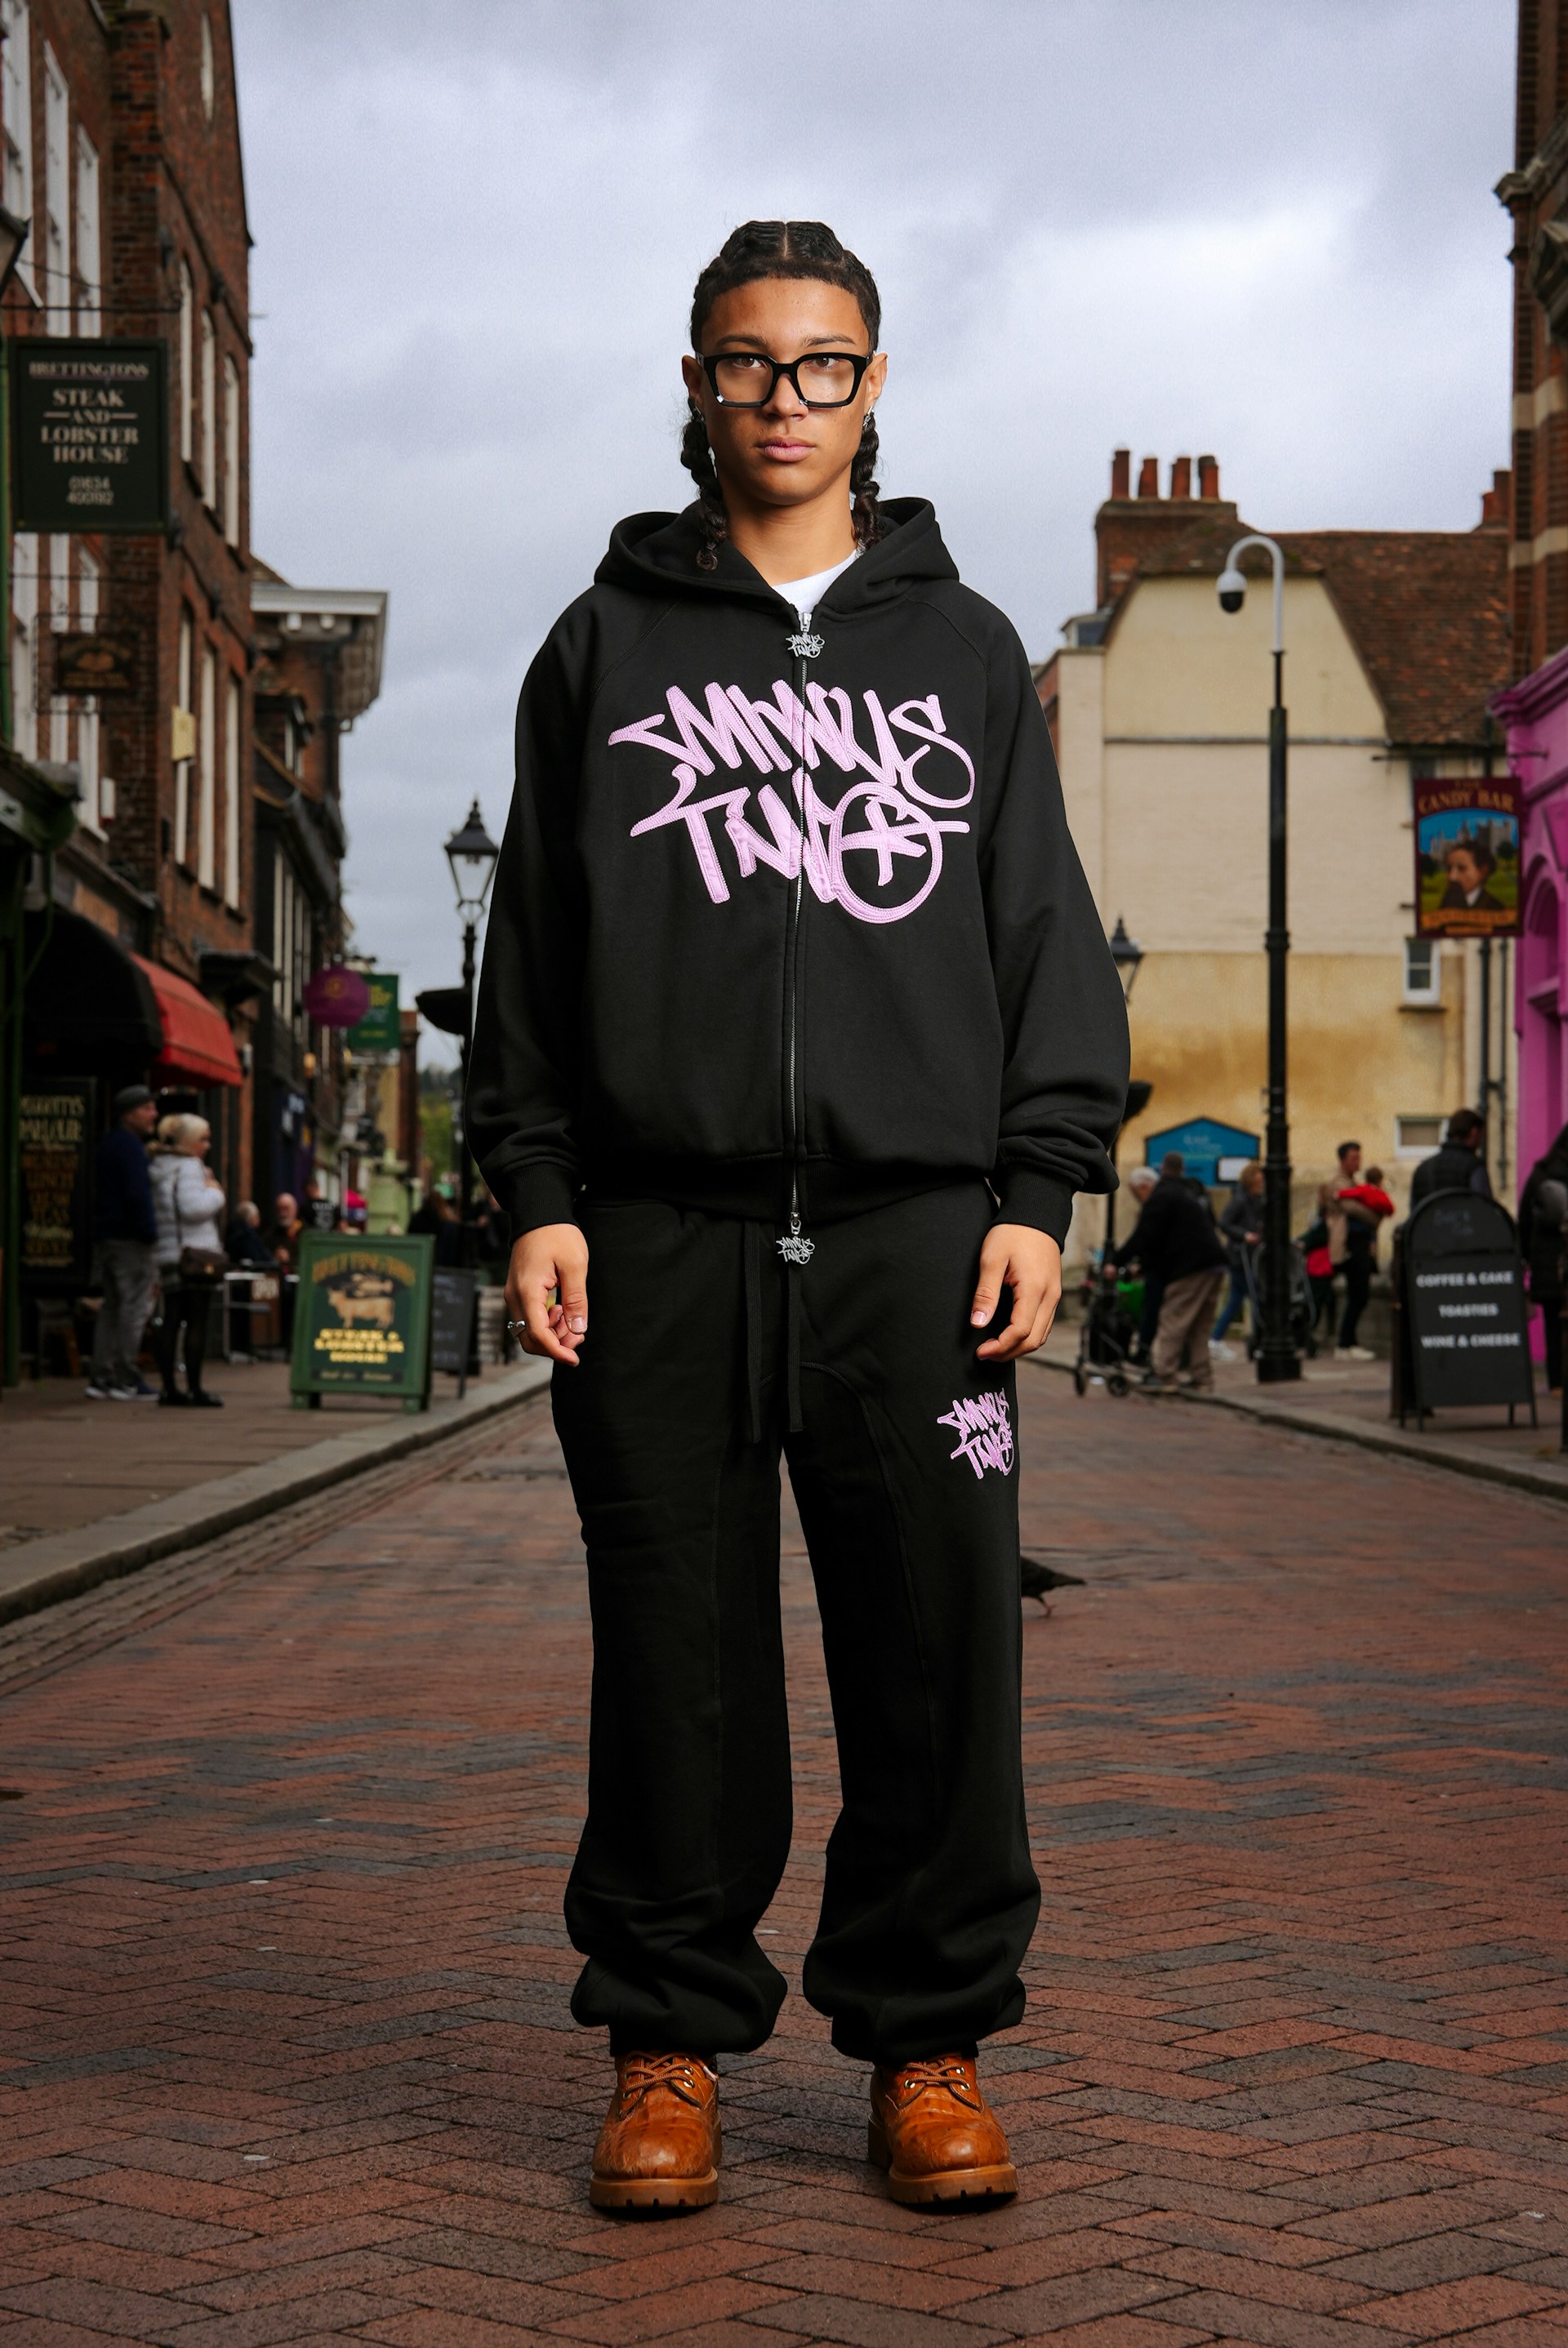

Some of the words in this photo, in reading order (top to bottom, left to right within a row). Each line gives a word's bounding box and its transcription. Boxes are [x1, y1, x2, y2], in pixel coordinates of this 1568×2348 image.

[52, 388, 125, 407] STEAK
[70, 409, 111, 424] AND
[41, 425, 139, 444] LOBSTER
[53, 445, 129, 464] HOUSE
[1418, 790, 1473, 814] CANDY
[1477, 789, 1514, 813] BAR
[1416, 1272, 1465, 1287] COFFEE
[1466, 1272, 1477, 1285] &
[1478, 1271, 1514, 1285] CAKE
[1438, 1303, 1499, 1317] TOASTIES
[1421, 1335, 1456, 1348] WINE
[1457, 1334, 1468, 1348] &
[1470, 1333, 1521, 1347] CHEESE
